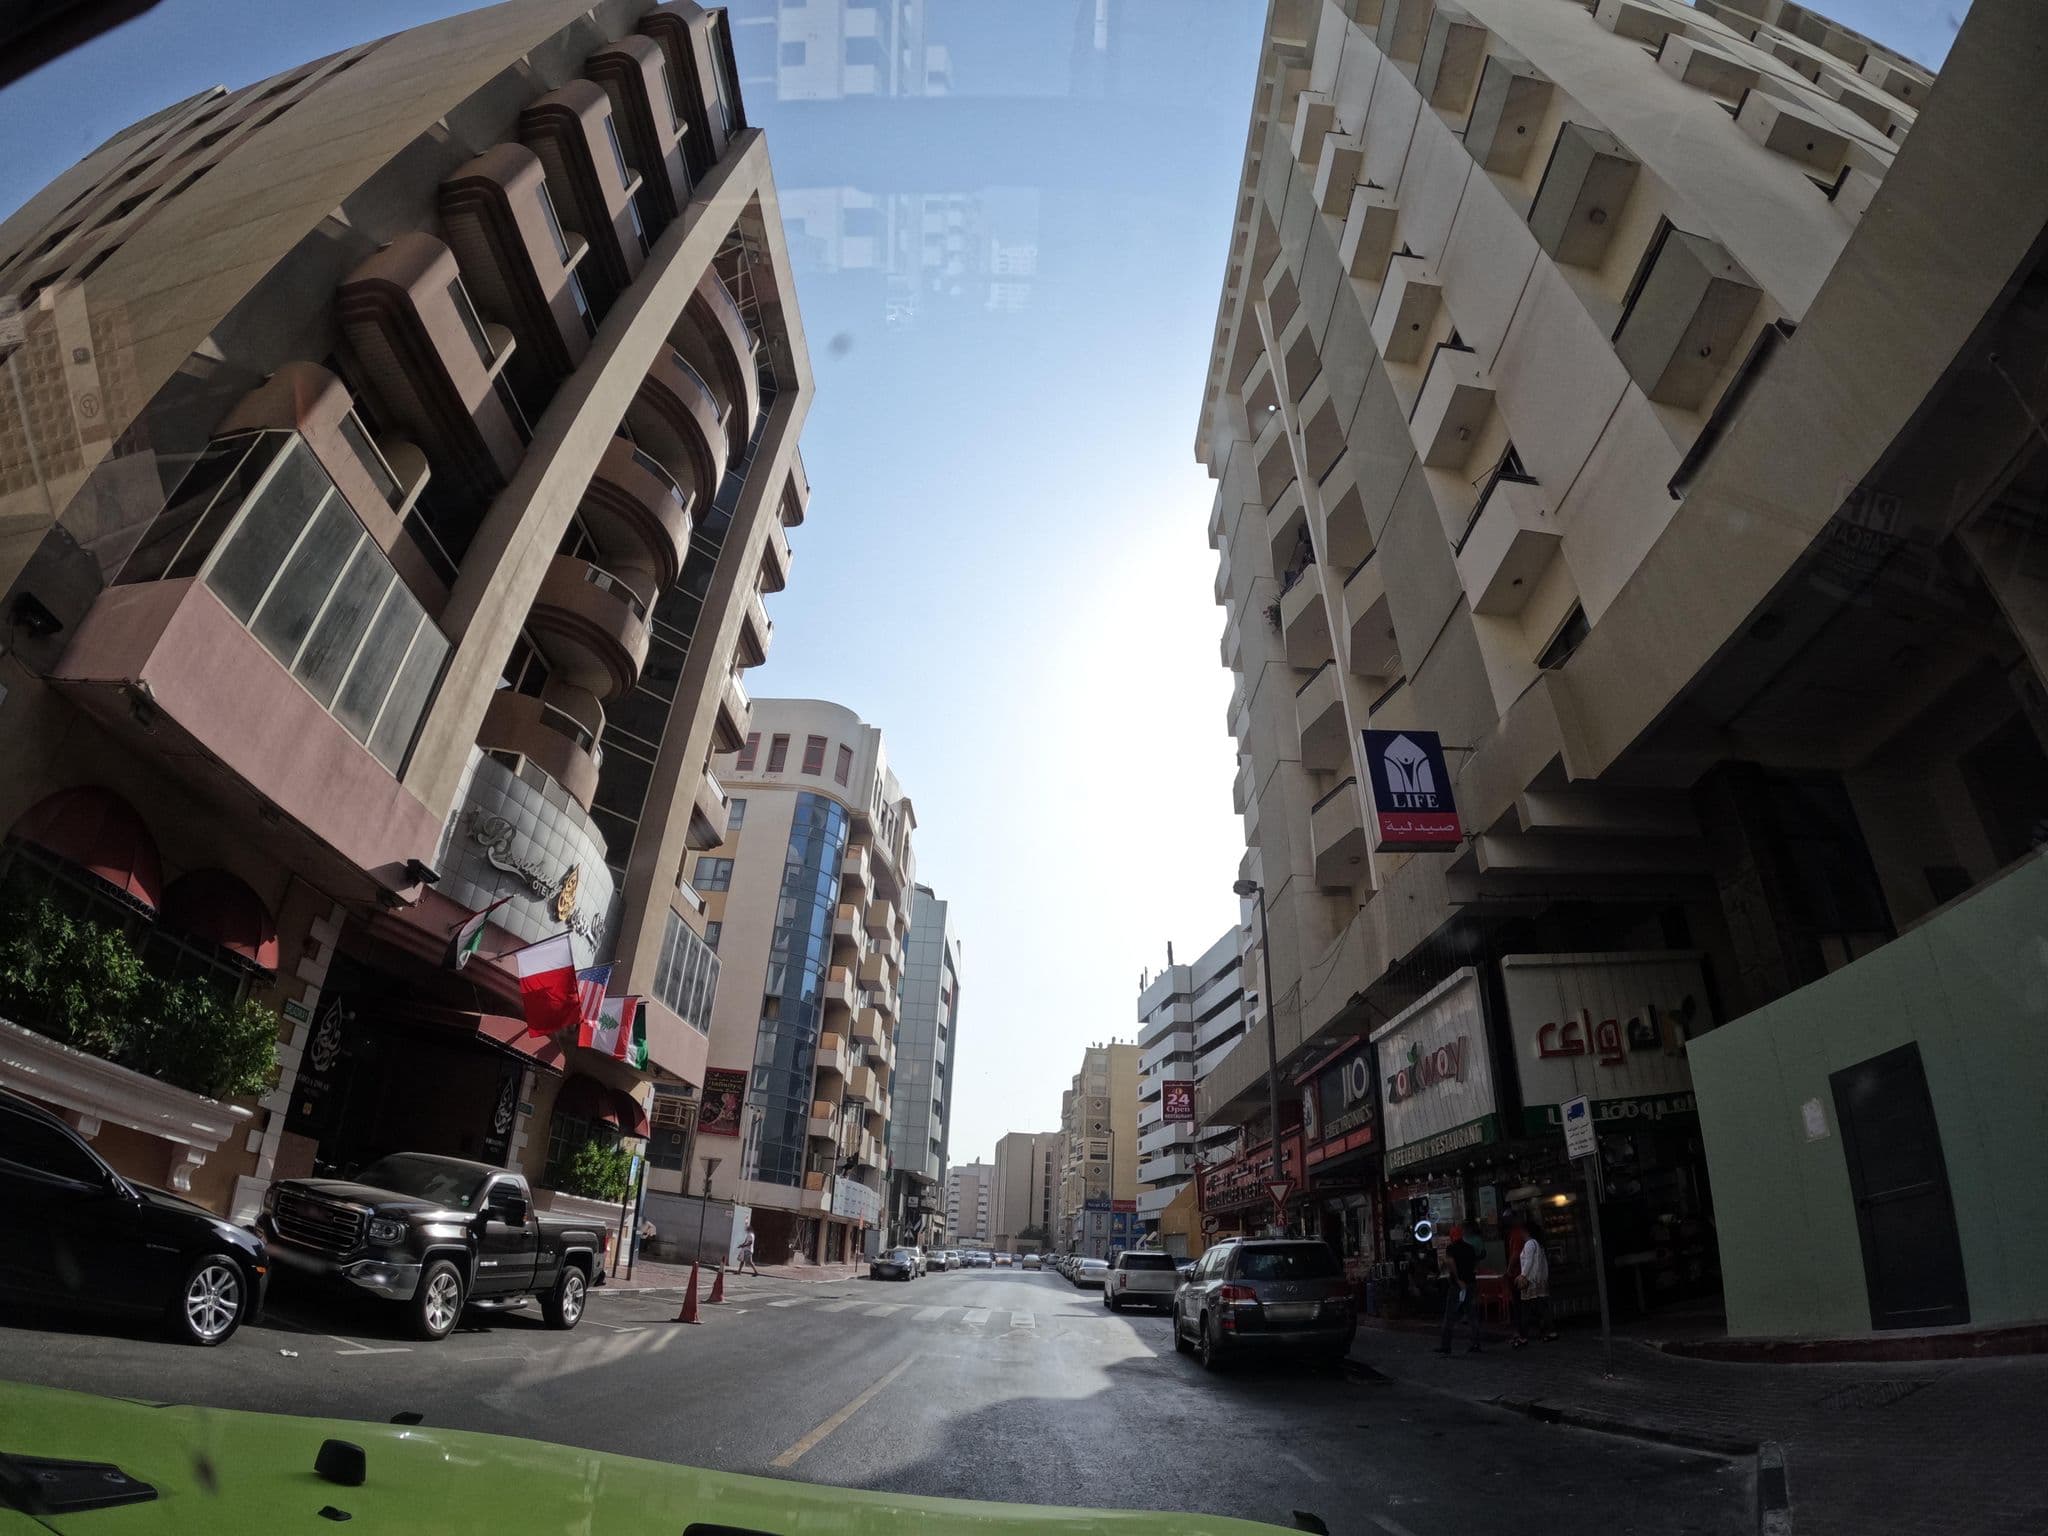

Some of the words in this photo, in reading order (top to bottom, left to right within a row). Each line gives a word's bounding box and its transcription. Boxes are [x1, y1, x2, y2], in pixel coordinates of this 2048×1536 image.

[1392, 793, 1440, 810] LIFE
[1384, 820, 1456, 836] صيدلية
[1167, 1093, 1191, 1105] 24
[1166, 1105, 1191, 1114] Open
[1431, 1123, 1483, 1158] RESTAURANT
